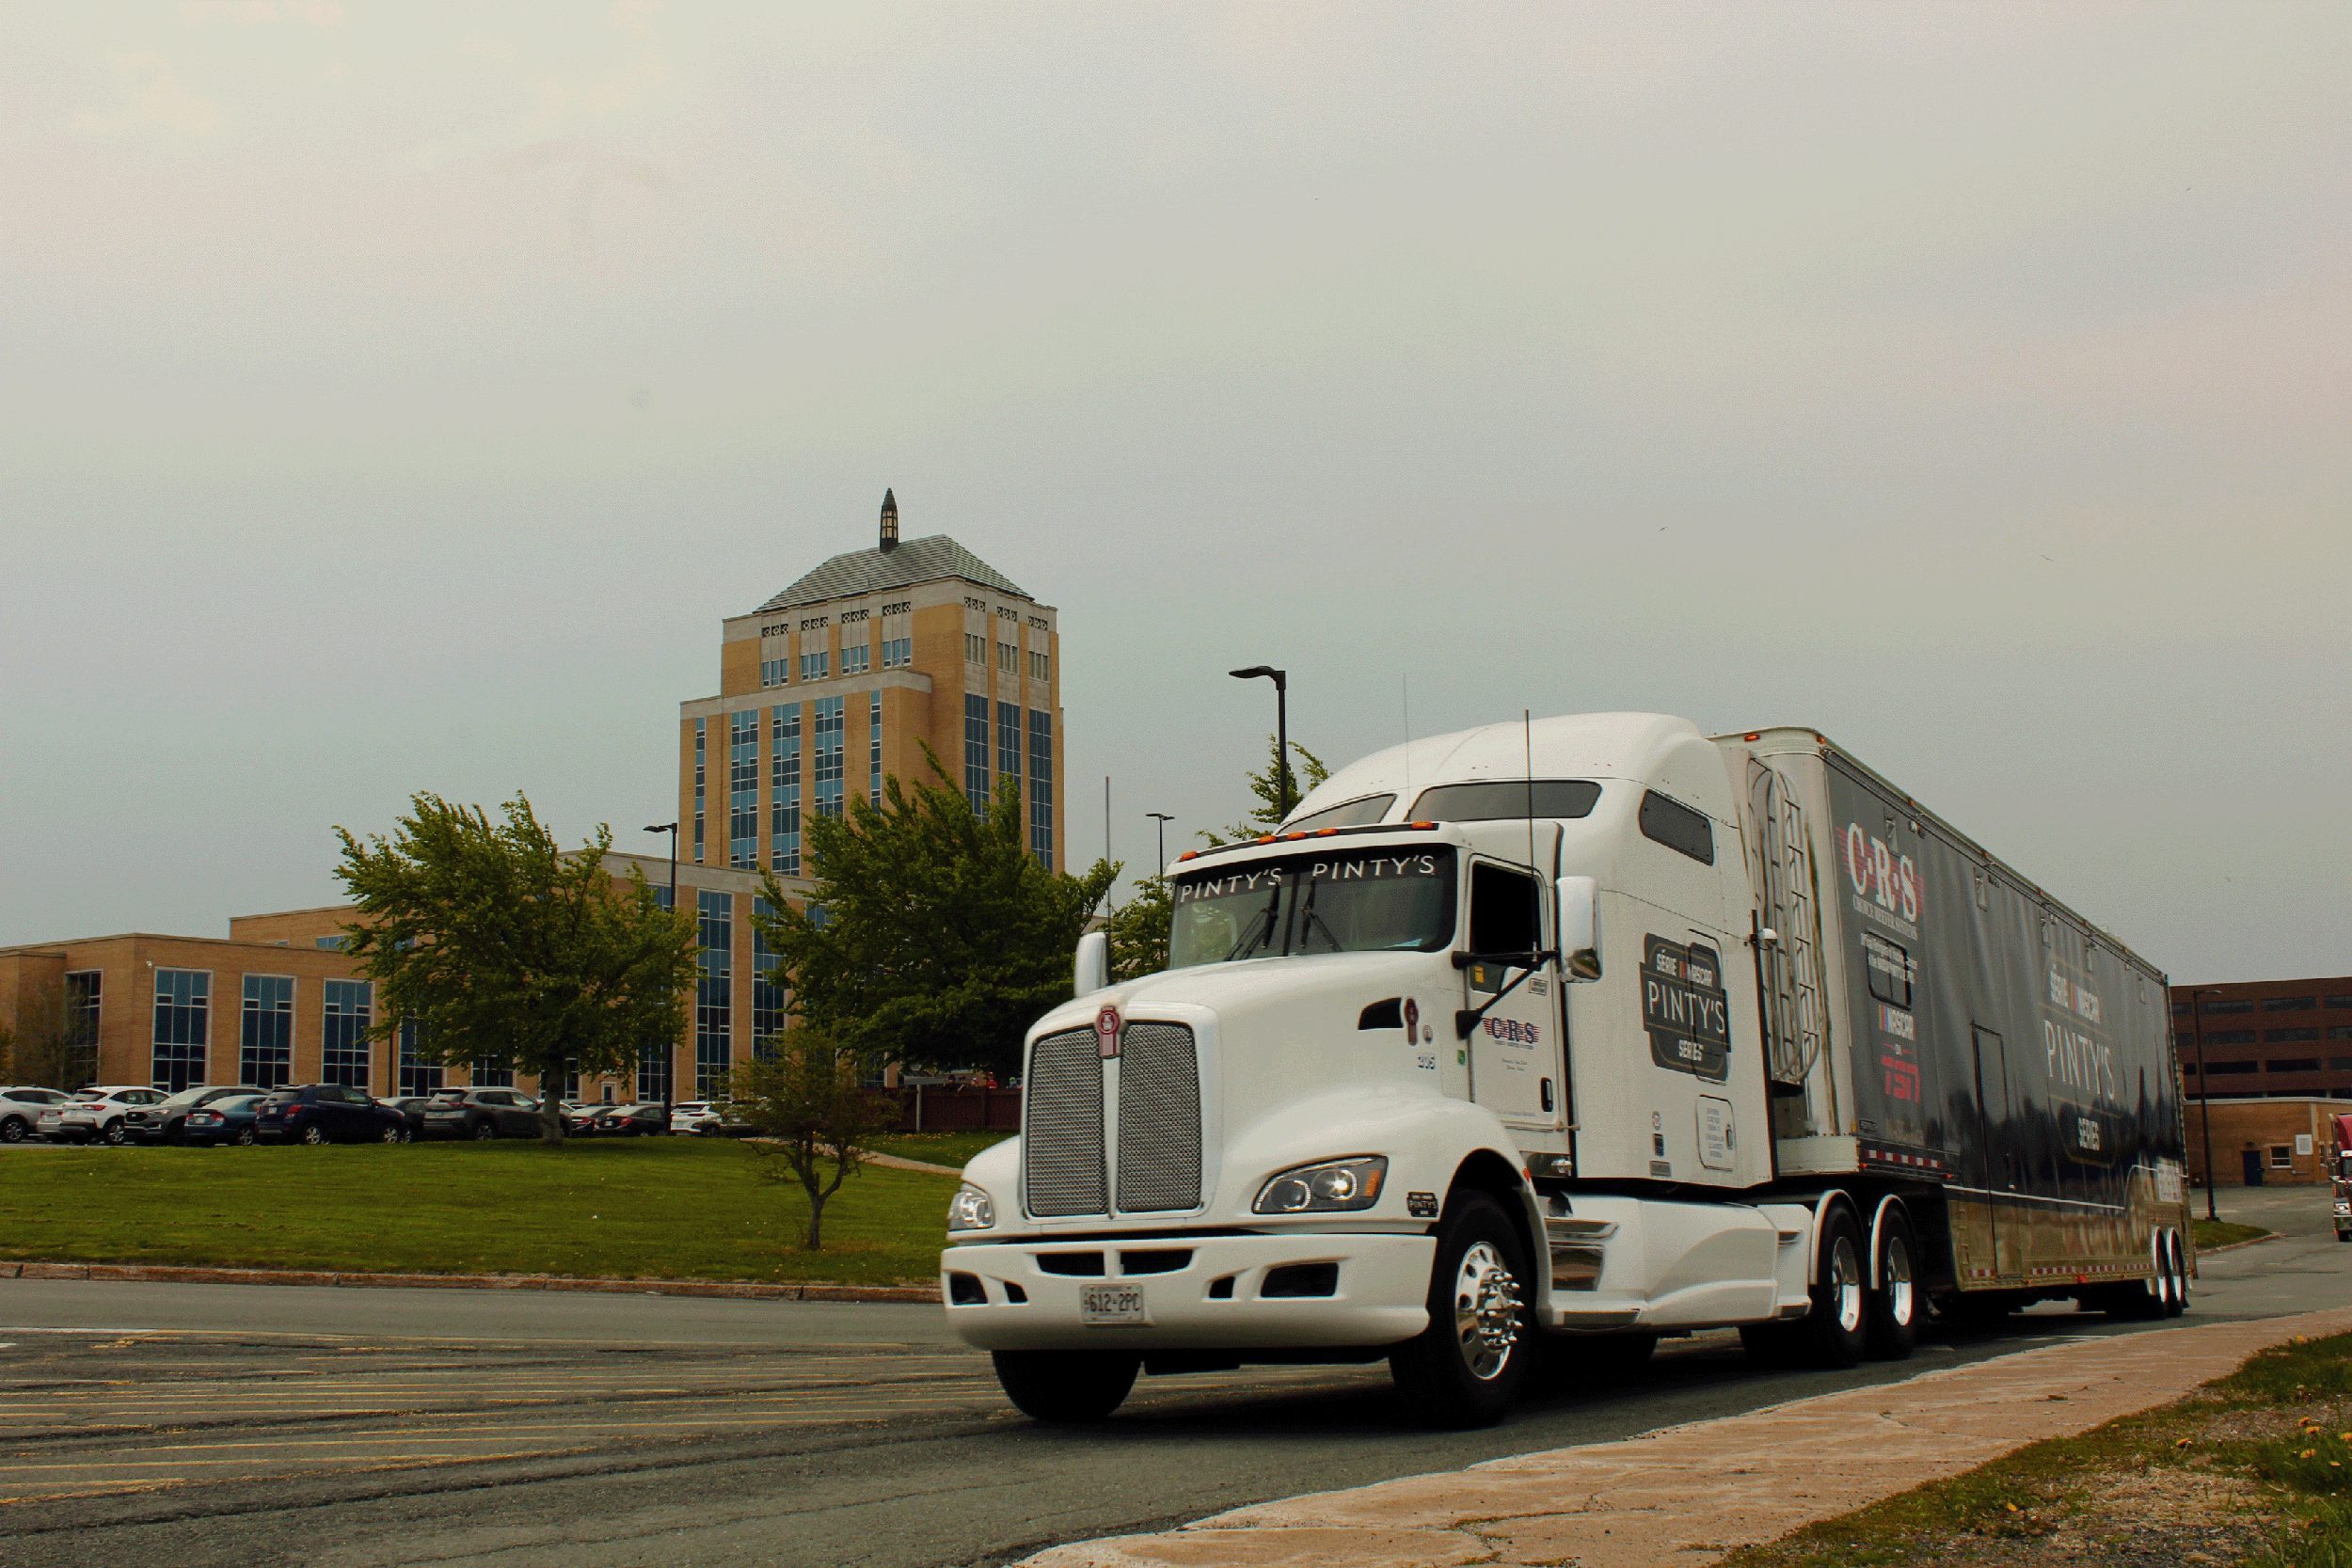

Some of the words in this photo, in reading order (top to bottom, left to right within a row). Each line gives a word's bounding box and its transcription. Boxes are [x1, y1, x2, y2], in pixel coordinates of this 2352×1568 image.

[1181, 868, 1281, 902] PINTY'S
[1312, 855, 1435, 879] PINTY'S
[1648, 981, 1724, 1034] PINTY'S
[2043, 1020, 2115, 1101] PINTY'S
